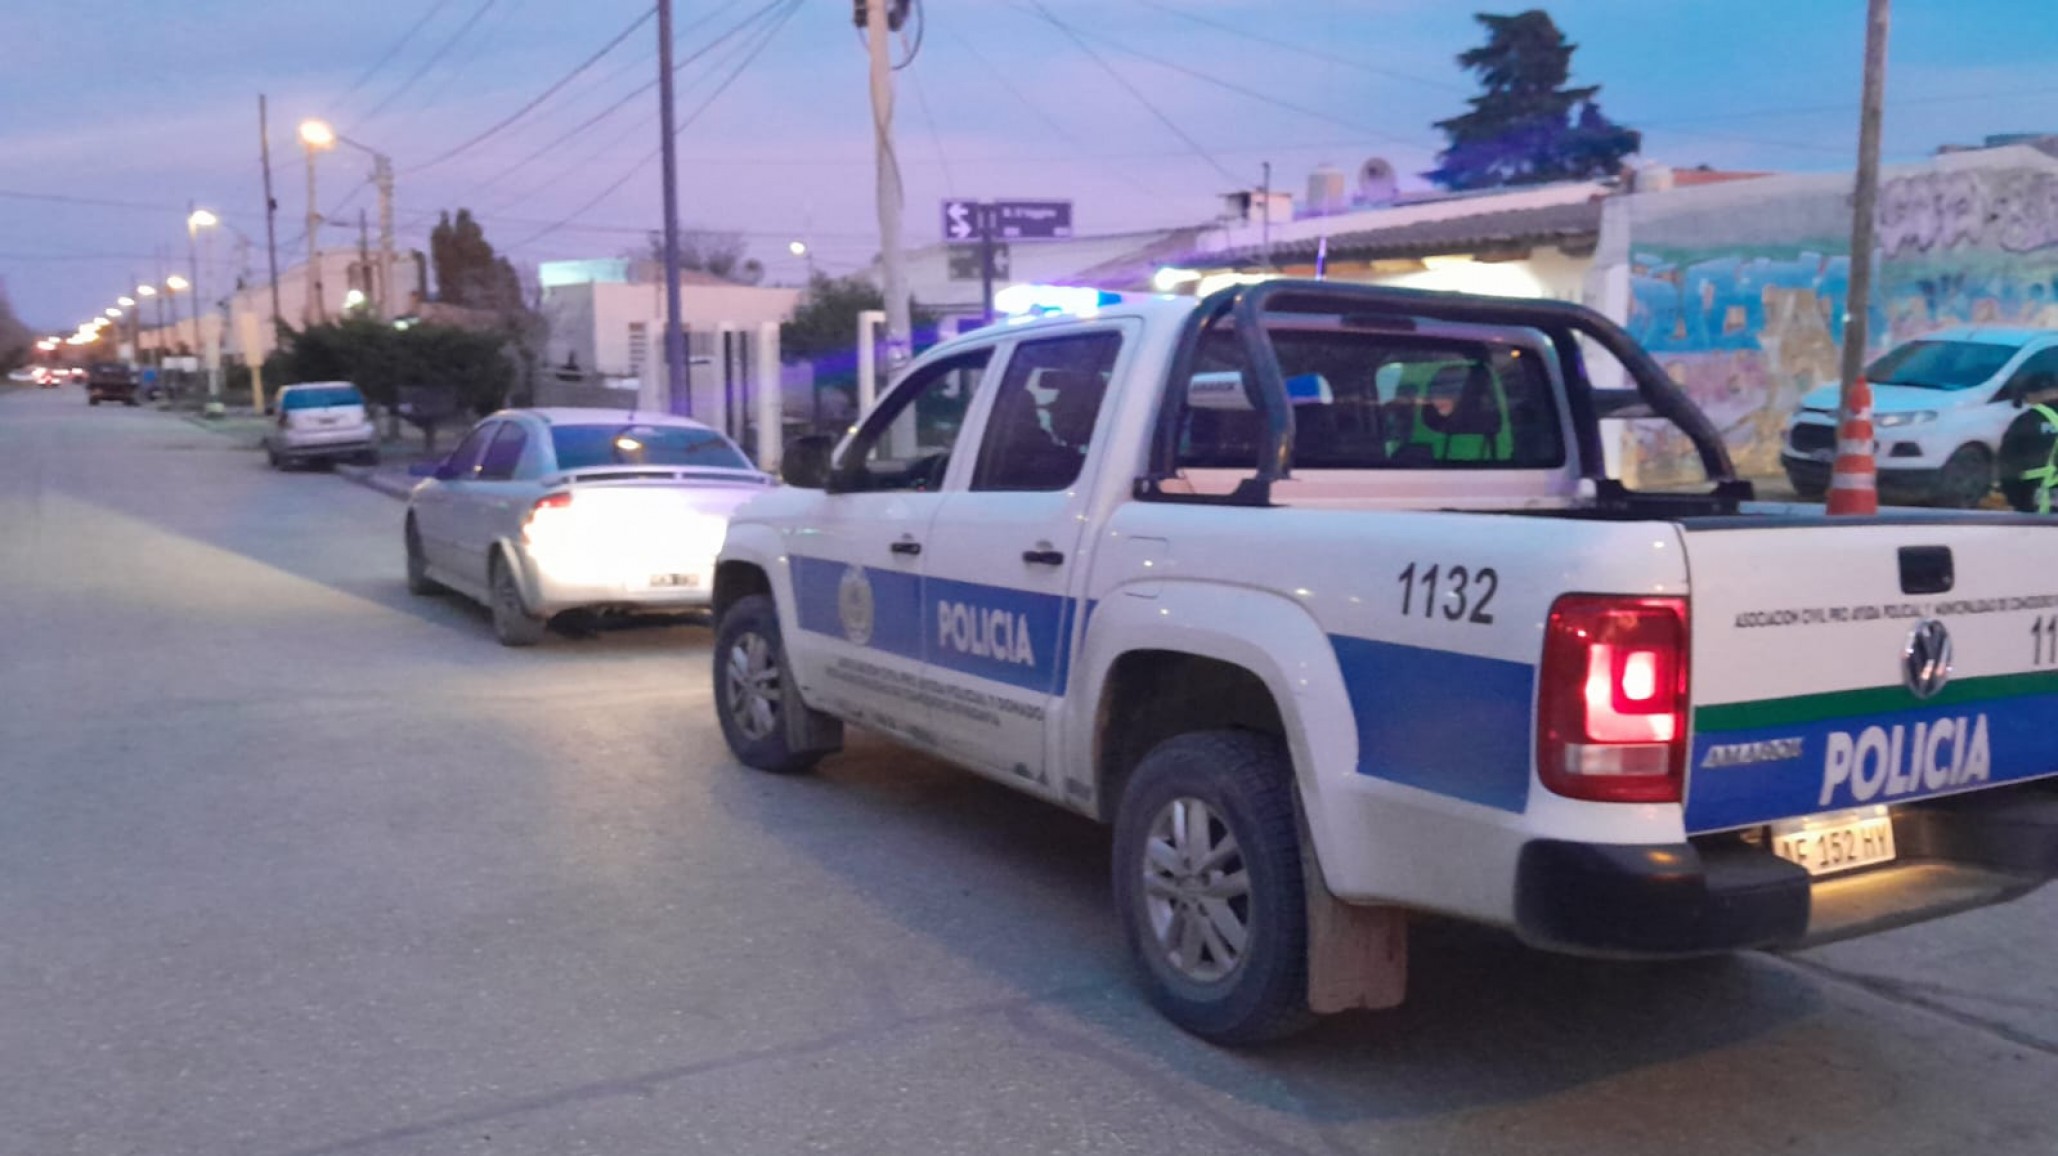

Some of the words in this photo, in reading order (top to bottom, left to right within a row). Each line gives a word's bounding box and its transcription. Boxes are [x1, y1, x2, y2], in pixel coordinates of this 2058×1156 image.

[1398, 561, 1498, 624] 1132
[937, 600, 1035, 666] POLICIA
[1819, 713, 1991, 806] POLICIA
[1818, 829, 1857, 868] 152
